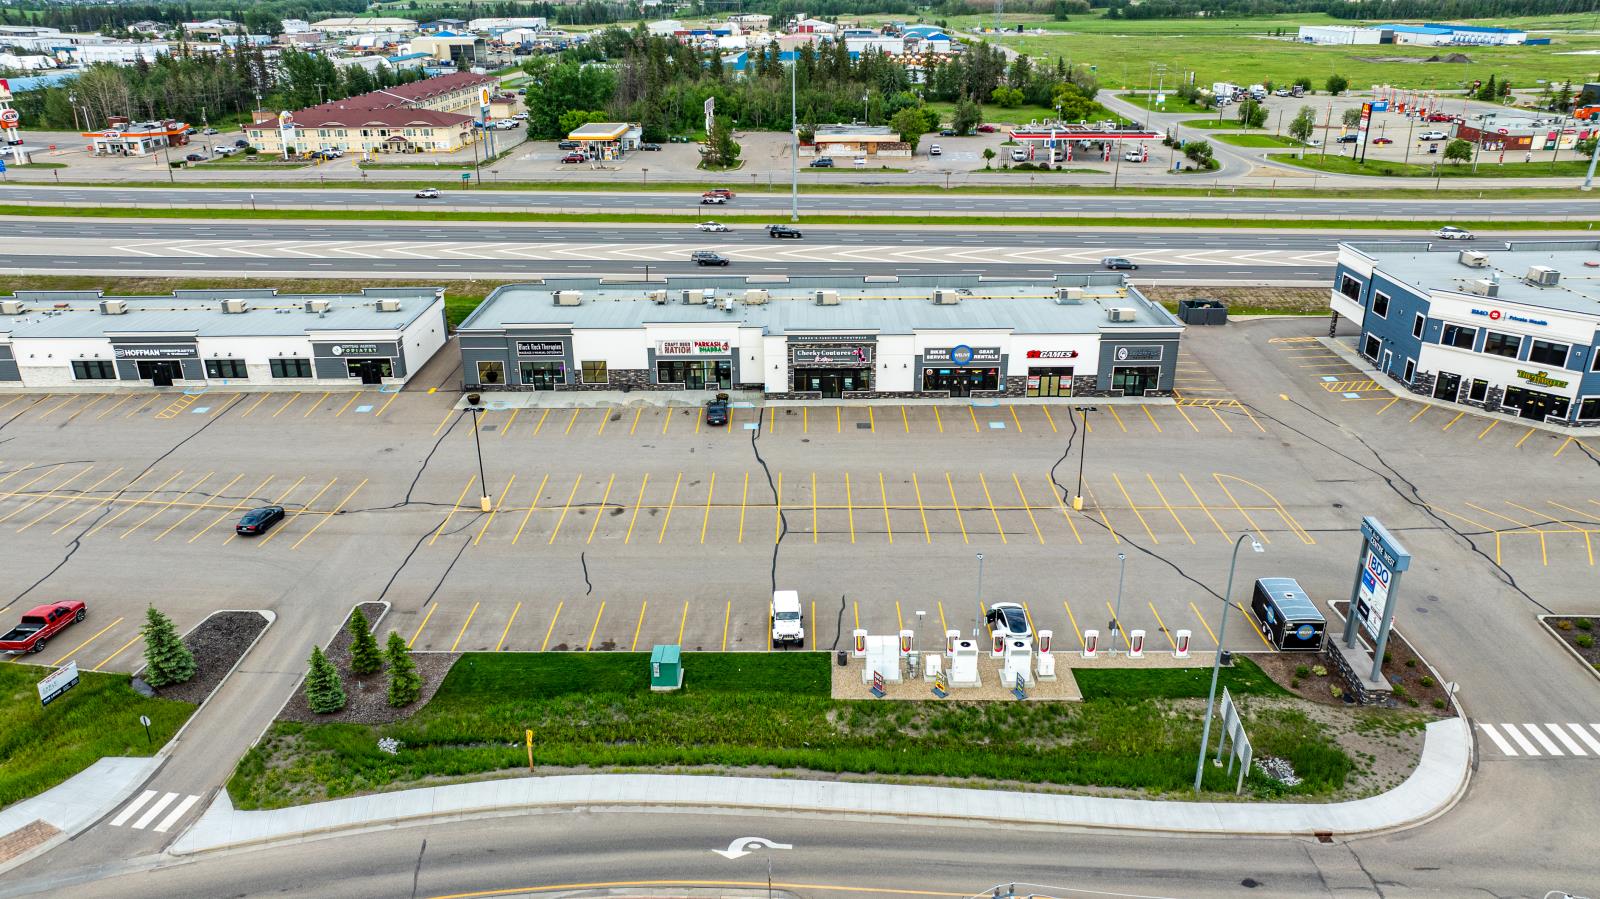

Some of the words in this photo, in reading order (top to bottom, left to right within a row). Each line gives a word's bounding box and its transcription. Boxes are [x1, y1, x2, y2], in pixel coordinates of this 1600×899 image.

[1471, 308, 1489, 316] BMO
[518, 343, 530, 351] Black
[541, 343, 562, 351] Therapies
[664, 346, 692, 354] NATION
[1040, 350, 1073, 358] GAMES
[1371, 556, 1388, 584] BDO
